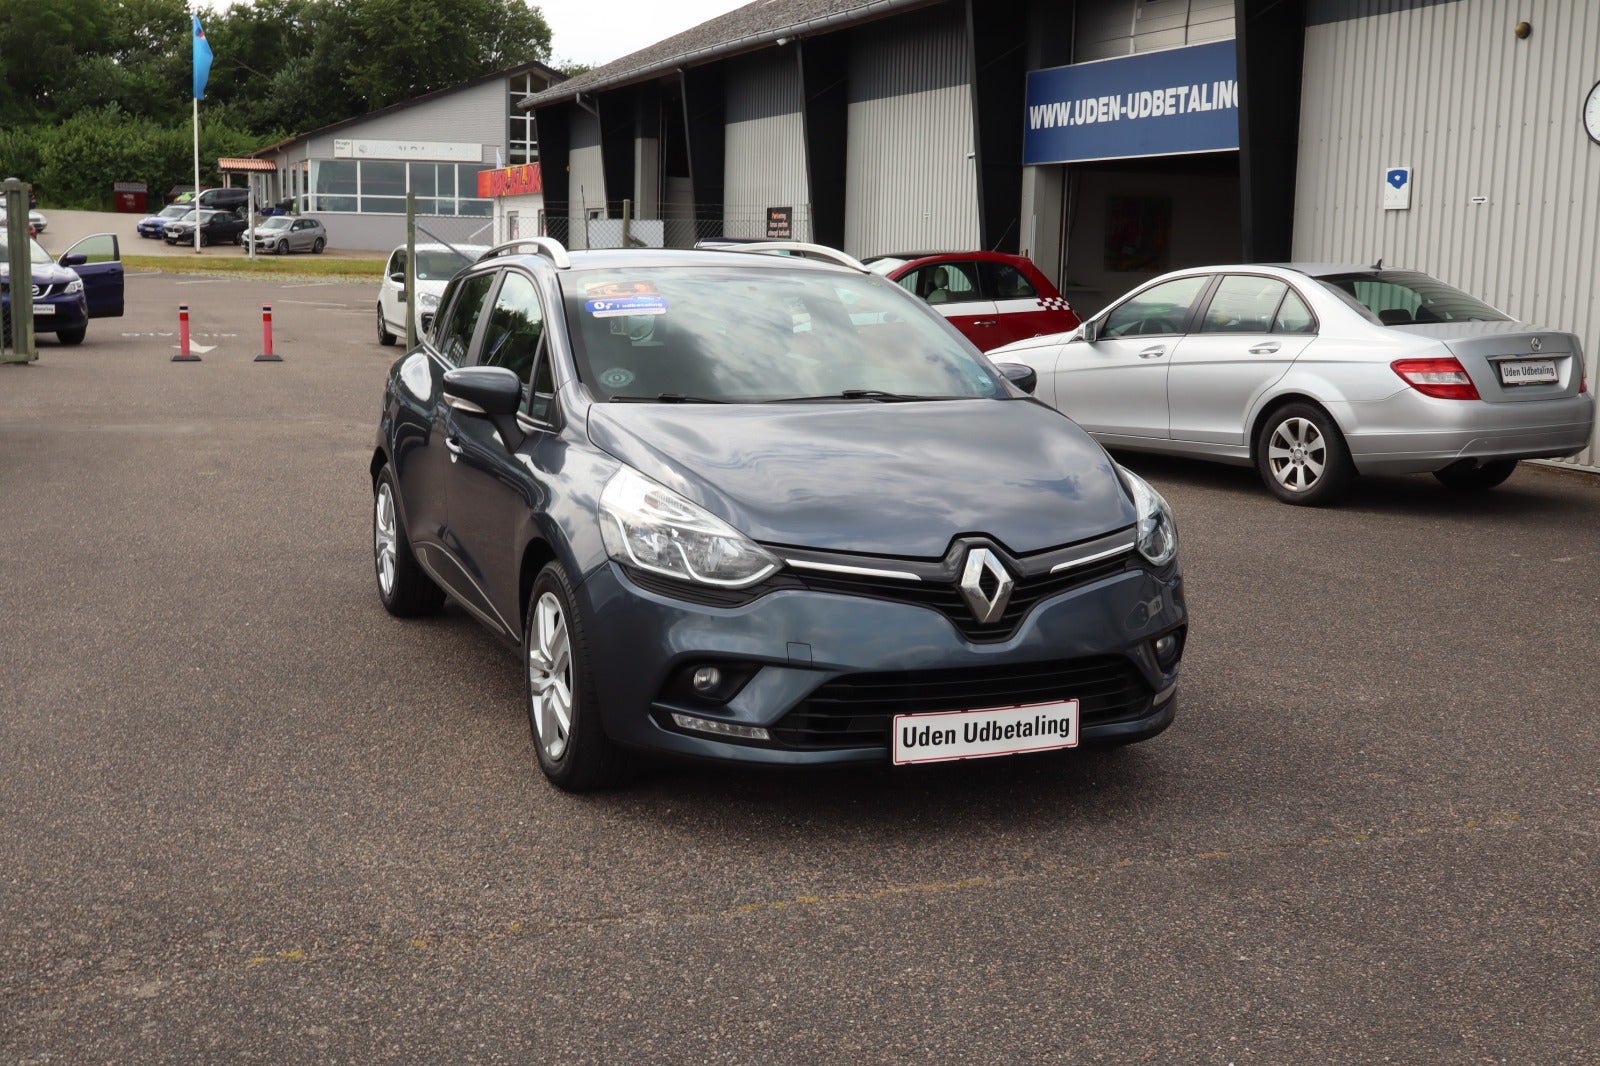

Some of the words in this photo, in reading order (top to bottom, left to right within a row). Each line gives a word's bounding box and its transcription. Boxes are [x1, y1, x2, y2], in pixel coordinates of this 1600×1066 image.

[1503, 367, 1521, 377] Uden
[1521, 365, 1555, 376] Udbetaling
[902, 725, 956, 748] Uden
[963, 714, 1070, 744] Udbetaling
